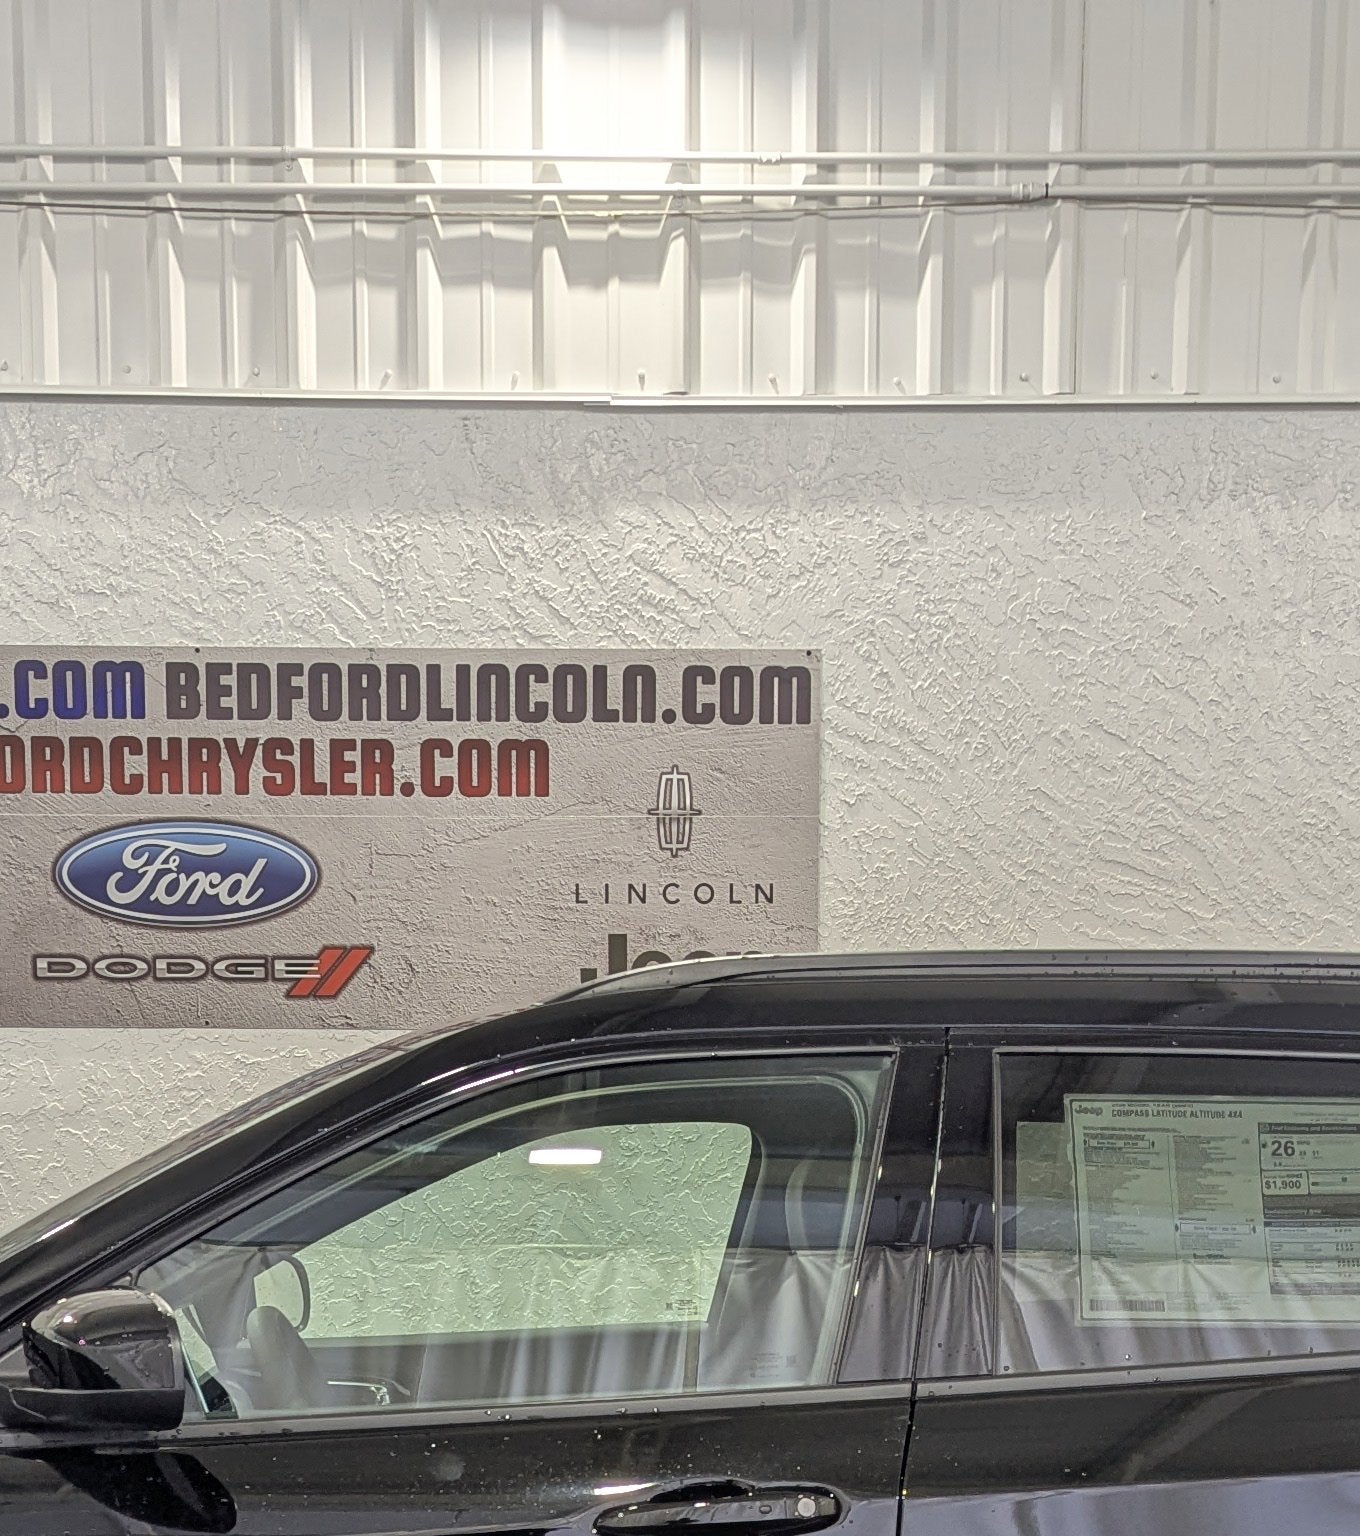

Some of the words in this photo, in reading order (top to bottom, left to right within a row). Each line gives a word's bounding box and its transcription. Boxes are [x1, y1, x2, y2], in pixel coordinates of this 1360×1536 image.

[165, 661, 812, 725] BEDFORDLINCOLN.COM
[106, 838, 268, 906] Ford
[574, 882, 774, 905] LINCOLN
[35, 957, 322, 980] DODGE
[1074, 1104, 1104, 1117] Jeep
[1111, 1109, 1150, 1119] COMPASS
[1151, 1109, 1188, 1119] LATITUDE
[1189, 1110, 1226, 1120] ALTITUDE
[1271, 1139, 1296, 1157] 26
